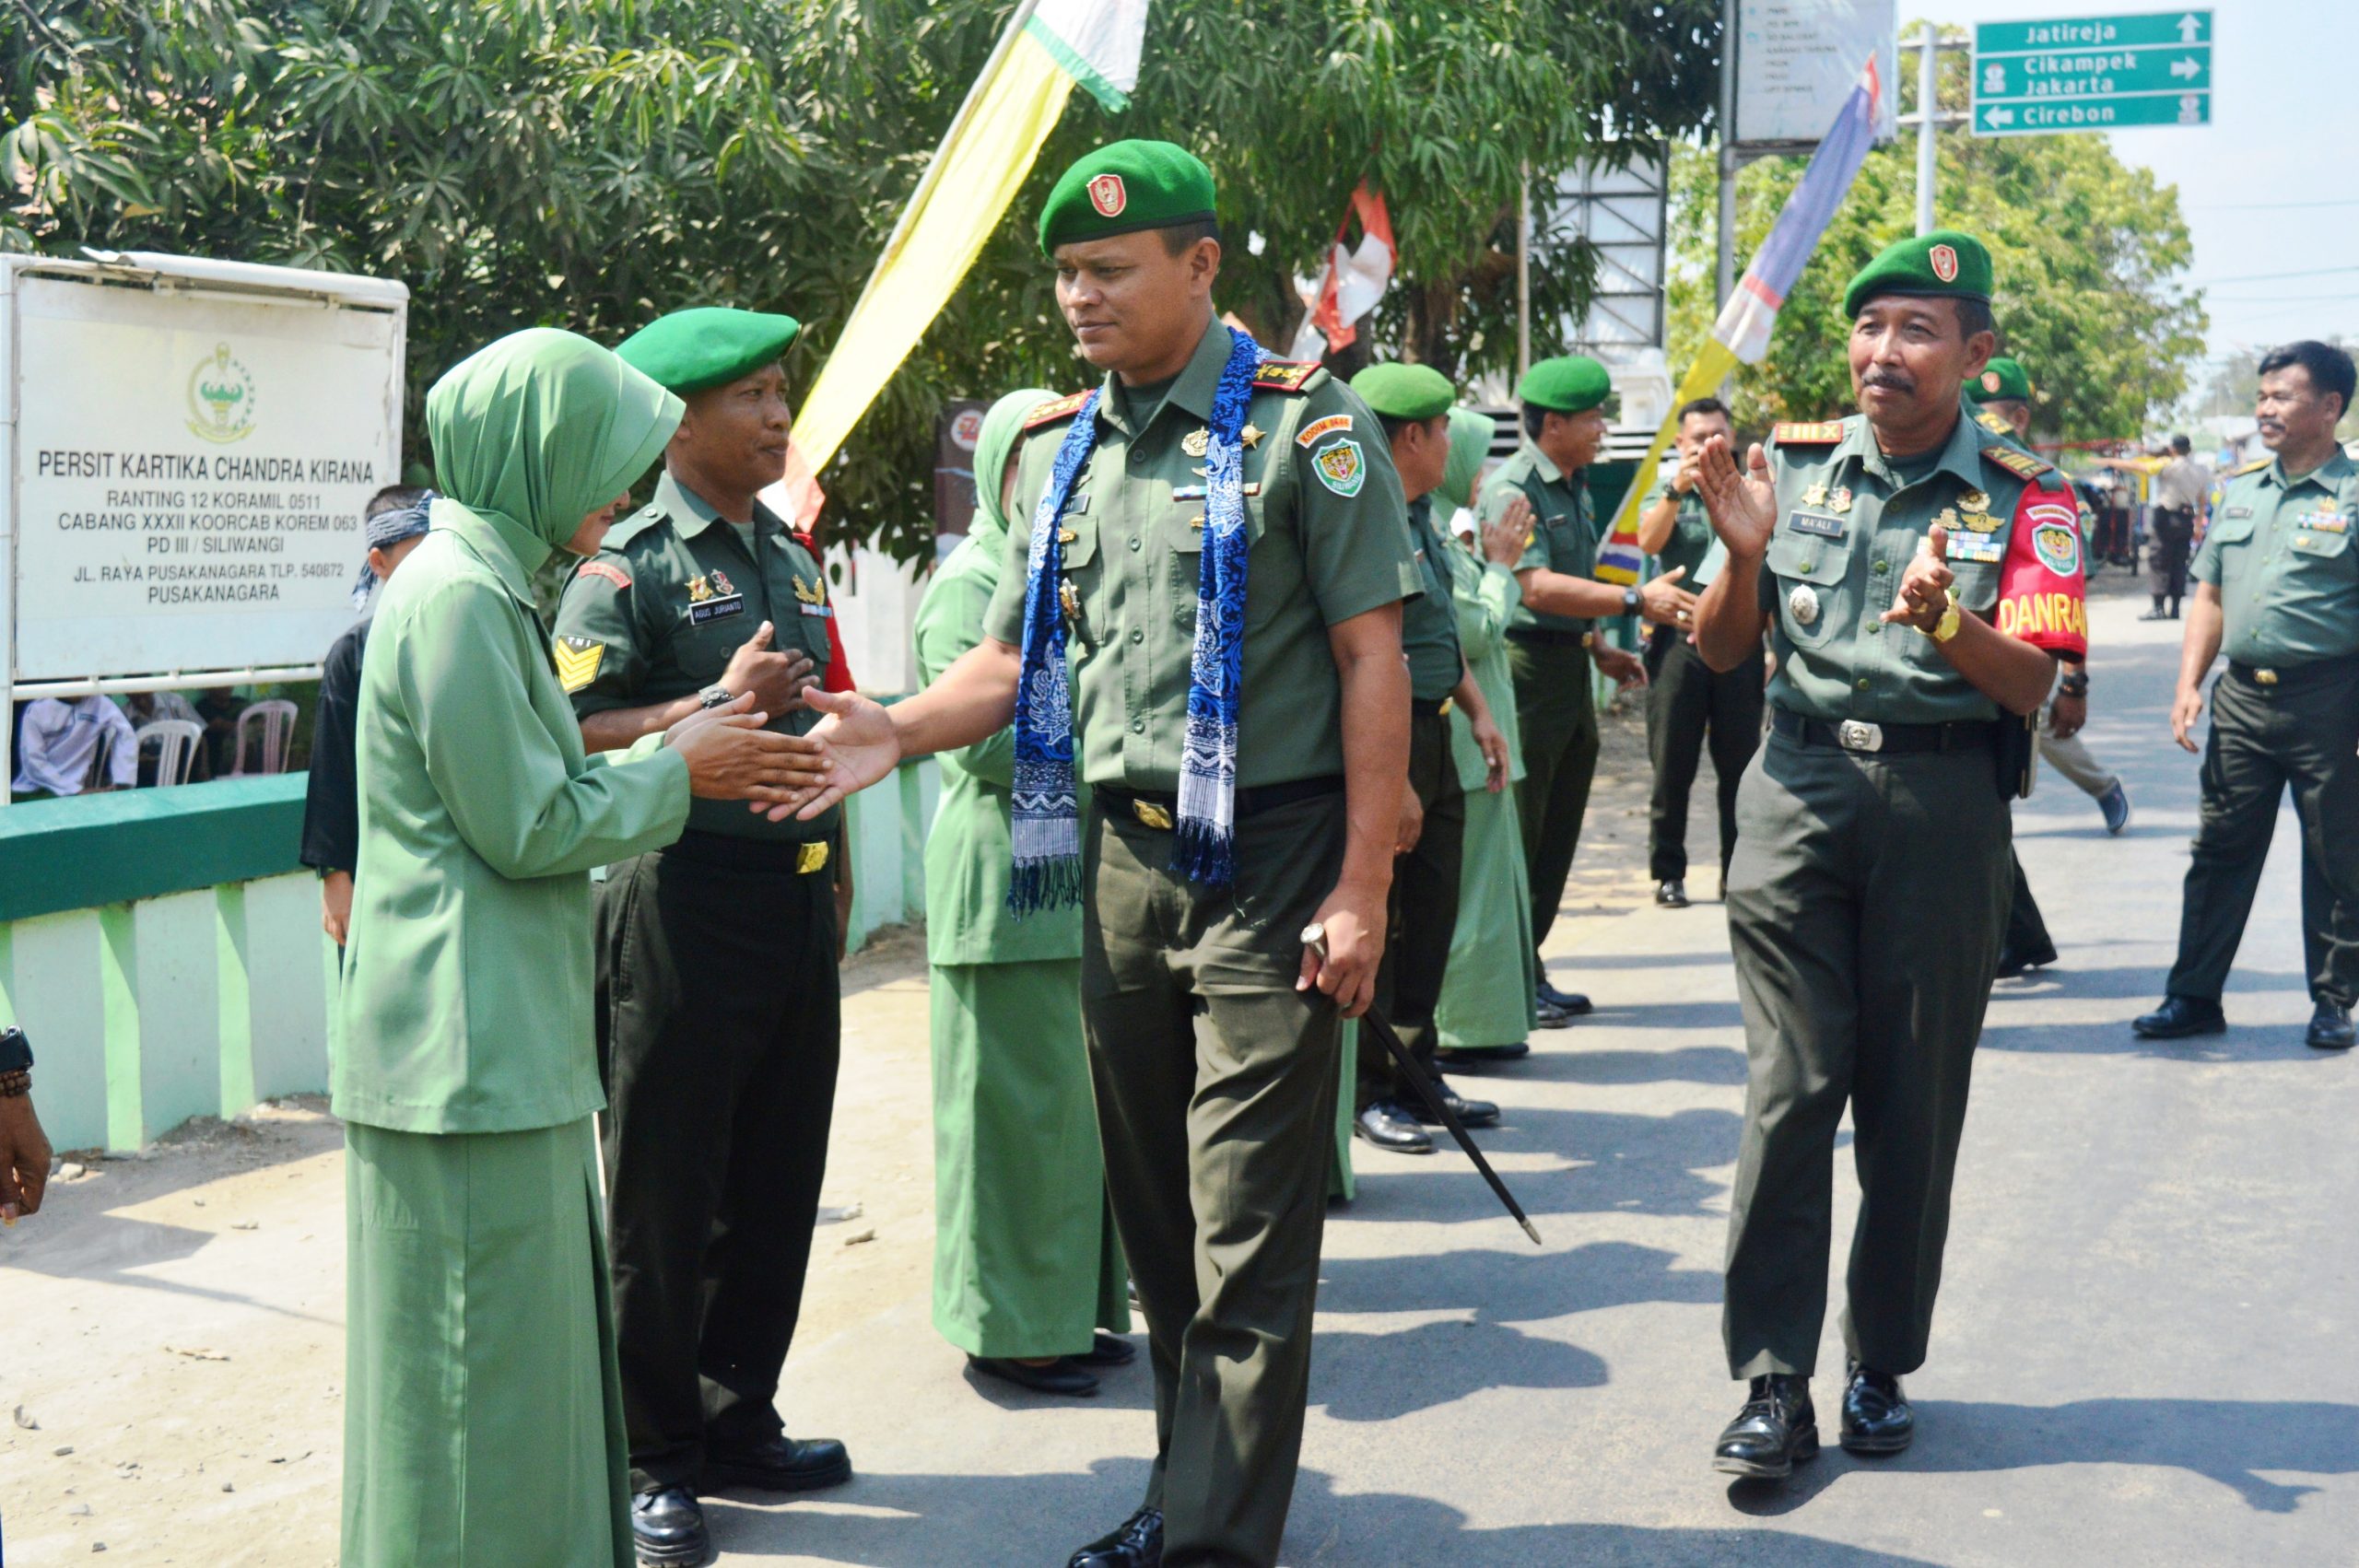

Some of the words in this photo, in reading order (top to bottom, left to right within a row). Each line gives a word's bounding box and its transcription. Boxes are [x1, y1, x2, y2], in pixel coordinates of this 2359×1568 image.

[2025, 22, 2117, 44] Jatireja
[2025, 53, 2137, 75] Cikampek
[2025, 76, 2114, 96] Jakarta
[2024, 106, 2115, 125] Cirebon
[39, 451, 114, 476] PERSIT
[121, 454, 209, 480] KARTIKA
[215, 457, 305, 482] CHANDRA
[310, 460, 374, 484] KIRANA
[106, 490, 186, 508] RANTING
[191, 492, 208, 508] 12
[213, 493, 284, 509] KORAMIL
[288, 494, 322, 509] 0511
[58, 512, 136, 531] CABANG
[142, 514, 185, 531] XXXII
[190, 514, 271, 531] KOORCAB
[275, 516, 330, 531] KOREM
[333, 516, 358, 531] 063
[147, 537, 170, 553] PD
[175, 537, 190, 553] III
[202, 537, 285, 554] SILIWANGI
[74, 566, 97, 583] JL.
[101, 566, 144, 582] RAYA
[148, 564, 267, 580] PUSAKANAGARA
[270, 564, 299, 579] TLP.
[301, 563, 345, 579] 540872
[147, 584, 280, 603] PUSAKANAGARA
[1999, 592, 2087, 639] DANRA
[568, 637, 592, 648] TNI
